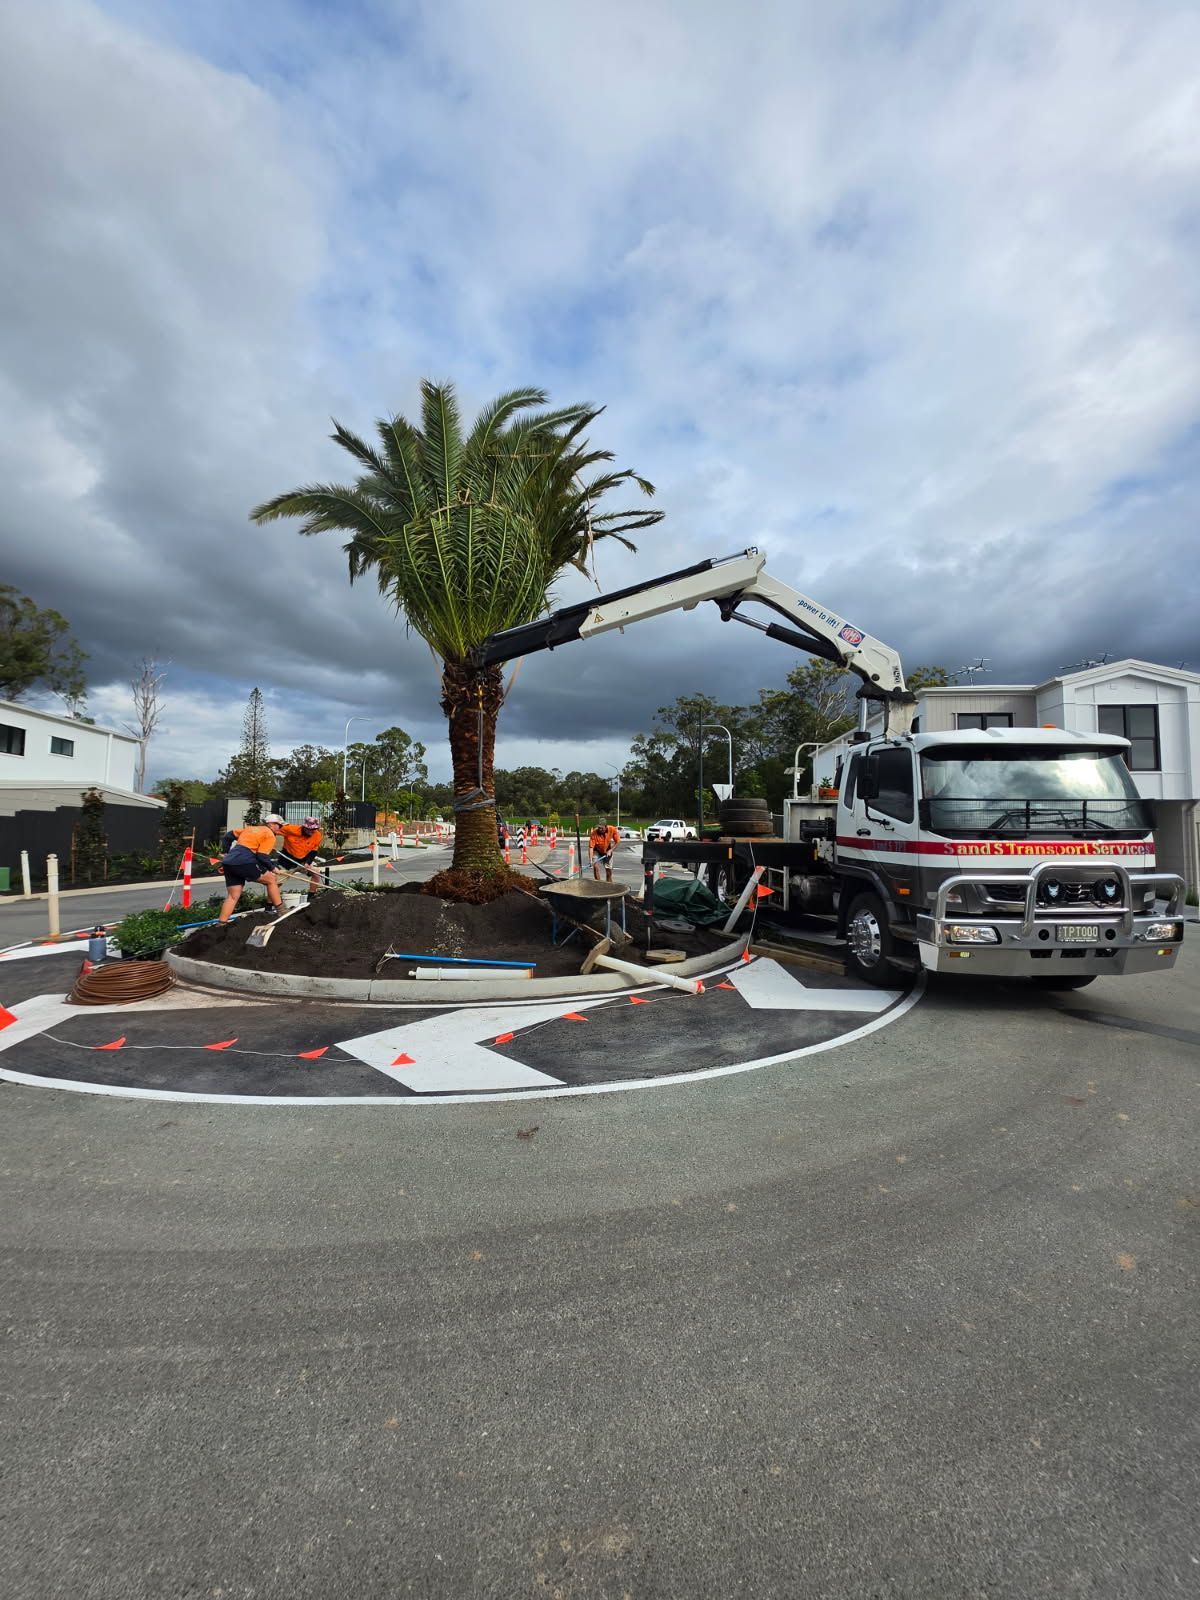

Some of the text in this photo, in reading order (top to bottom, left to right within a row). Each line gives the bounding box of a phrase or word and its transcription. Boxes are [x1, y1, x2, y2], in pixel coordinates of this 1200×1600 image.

[819, 612, 826, 620] to
[826, 616, 840, 629] lift!
[943, 842, 1151, 856] S and S Transport Services
